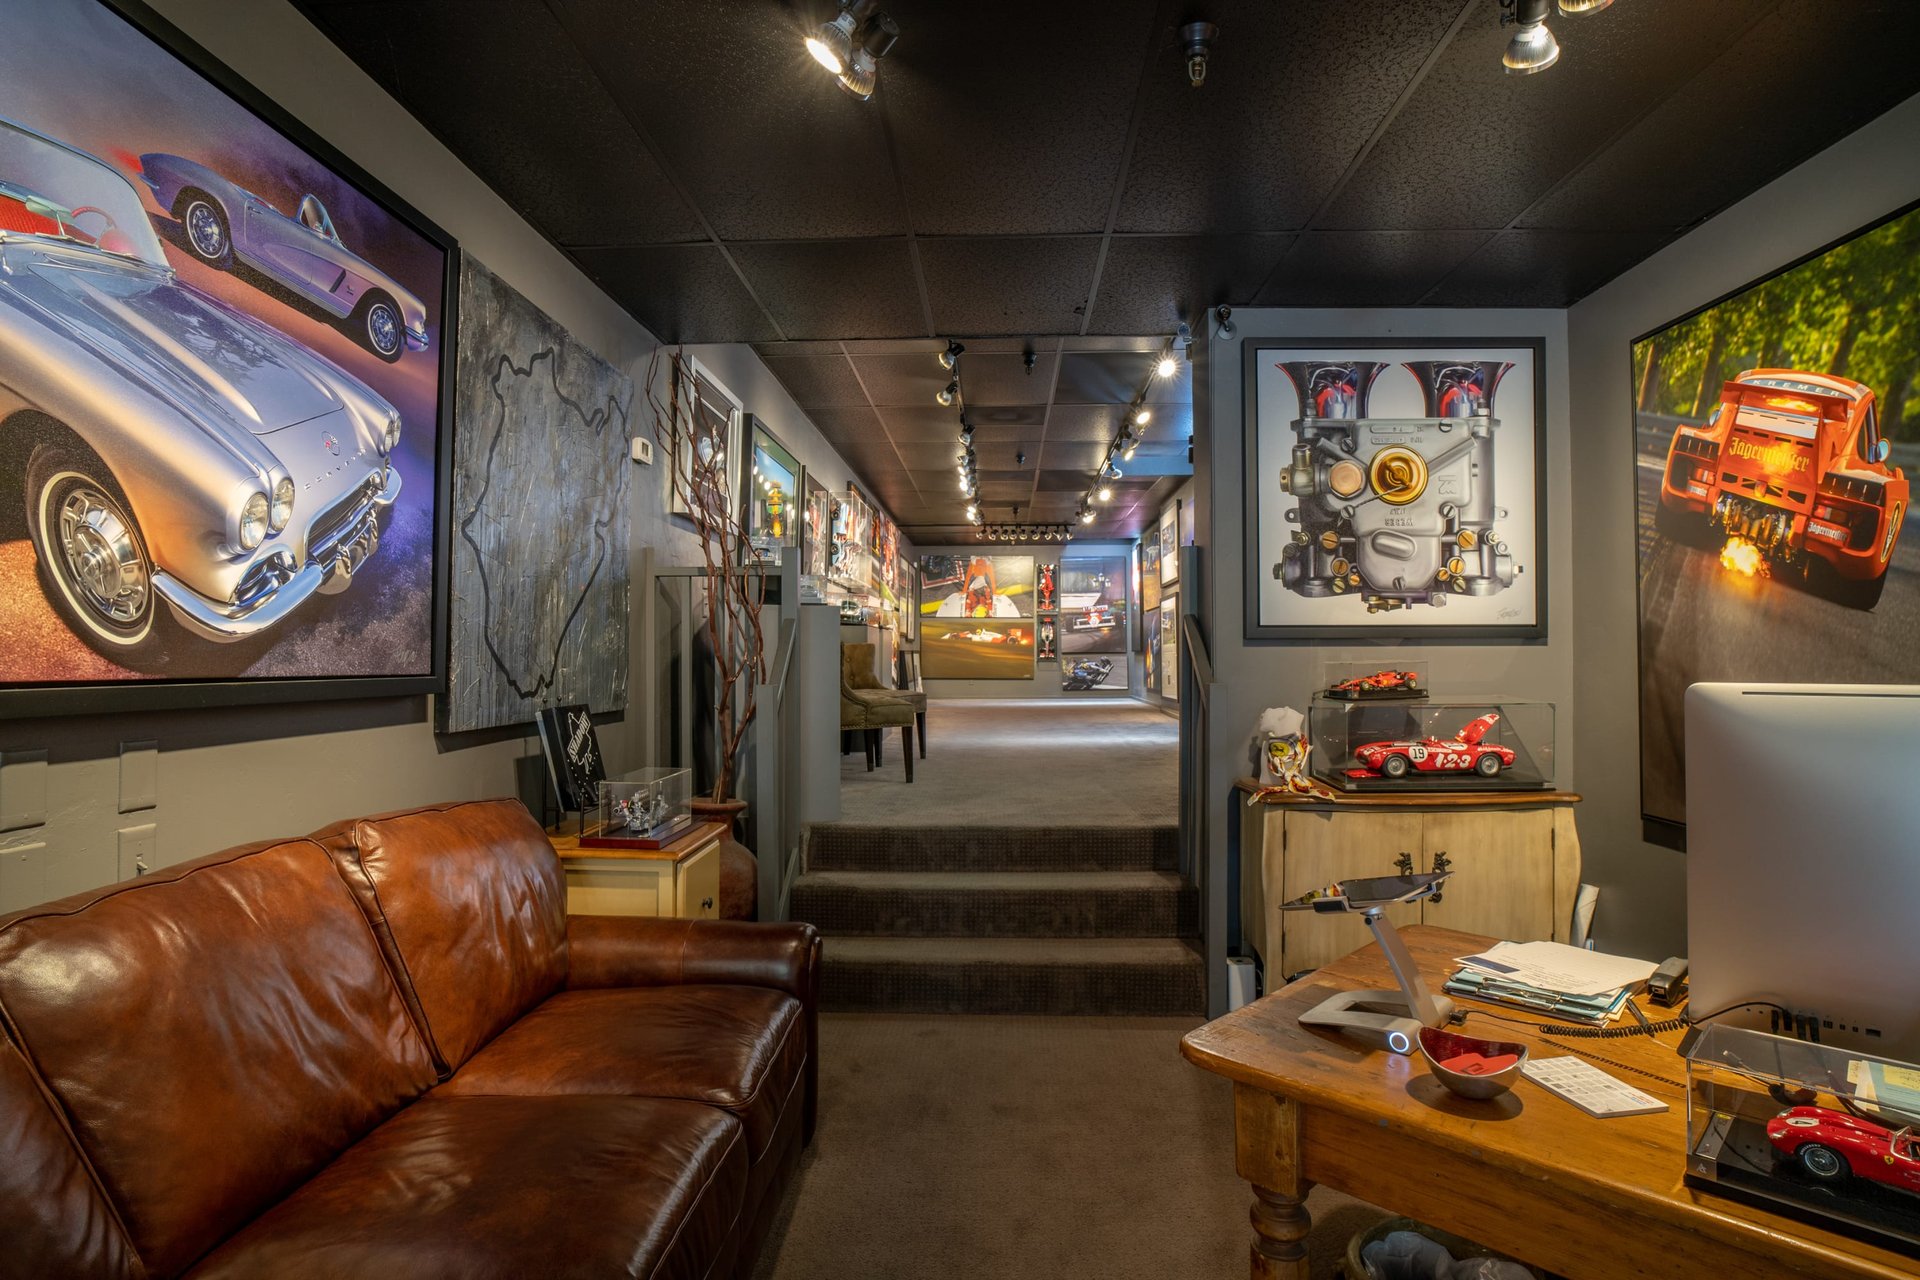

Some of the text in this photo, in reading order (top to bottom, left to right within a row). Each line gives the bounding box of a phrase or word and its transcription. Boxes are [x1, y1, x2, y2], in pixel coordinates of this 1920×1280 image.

[1752, 379, 1840, 397] KREMER
[1384, 518, 1414, 527] WEBER
[1412, 748, 1425, 760] 19
